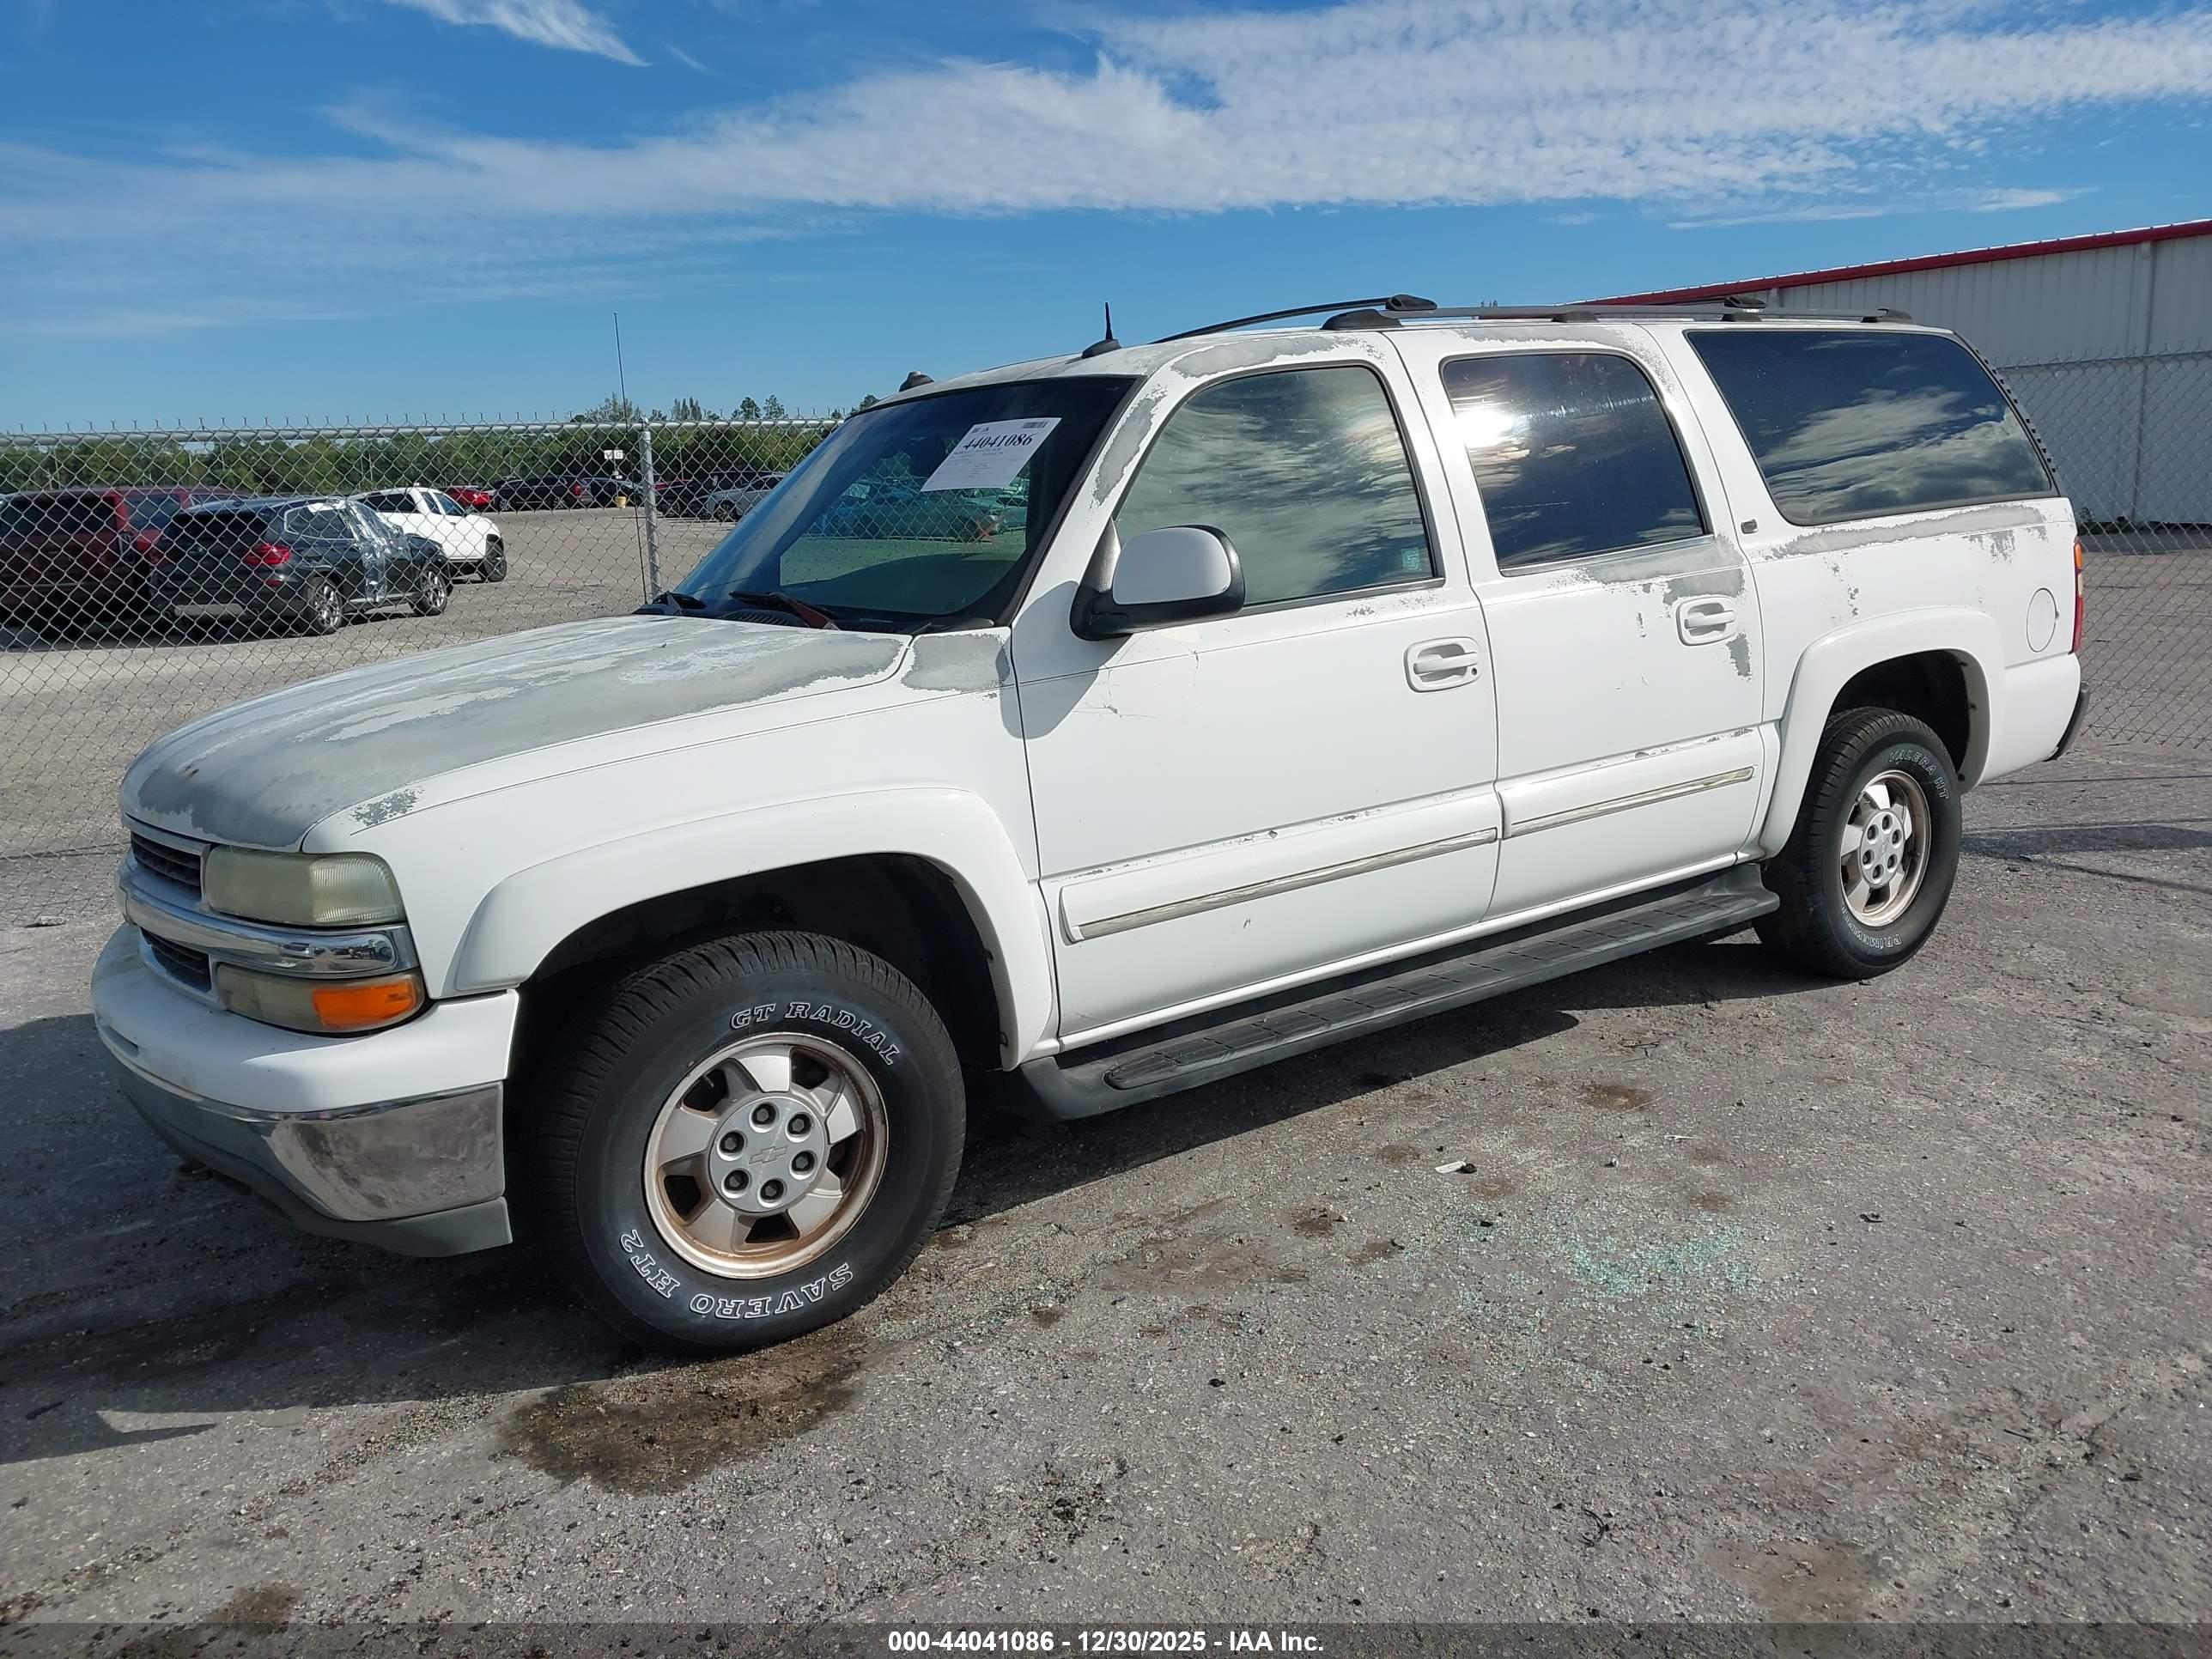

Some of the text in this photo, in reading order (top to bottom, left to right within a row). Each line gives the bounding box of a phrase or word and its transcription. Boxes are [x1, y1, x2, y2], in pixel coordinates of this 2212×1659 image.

[963, 433, 1036, 450] 44041086
[1934, 776, 1949, 799] HT
[731, 1001, 900, 1066] GT RADIAL
[620, 1229, 854, 1319] SAVERO HT2
